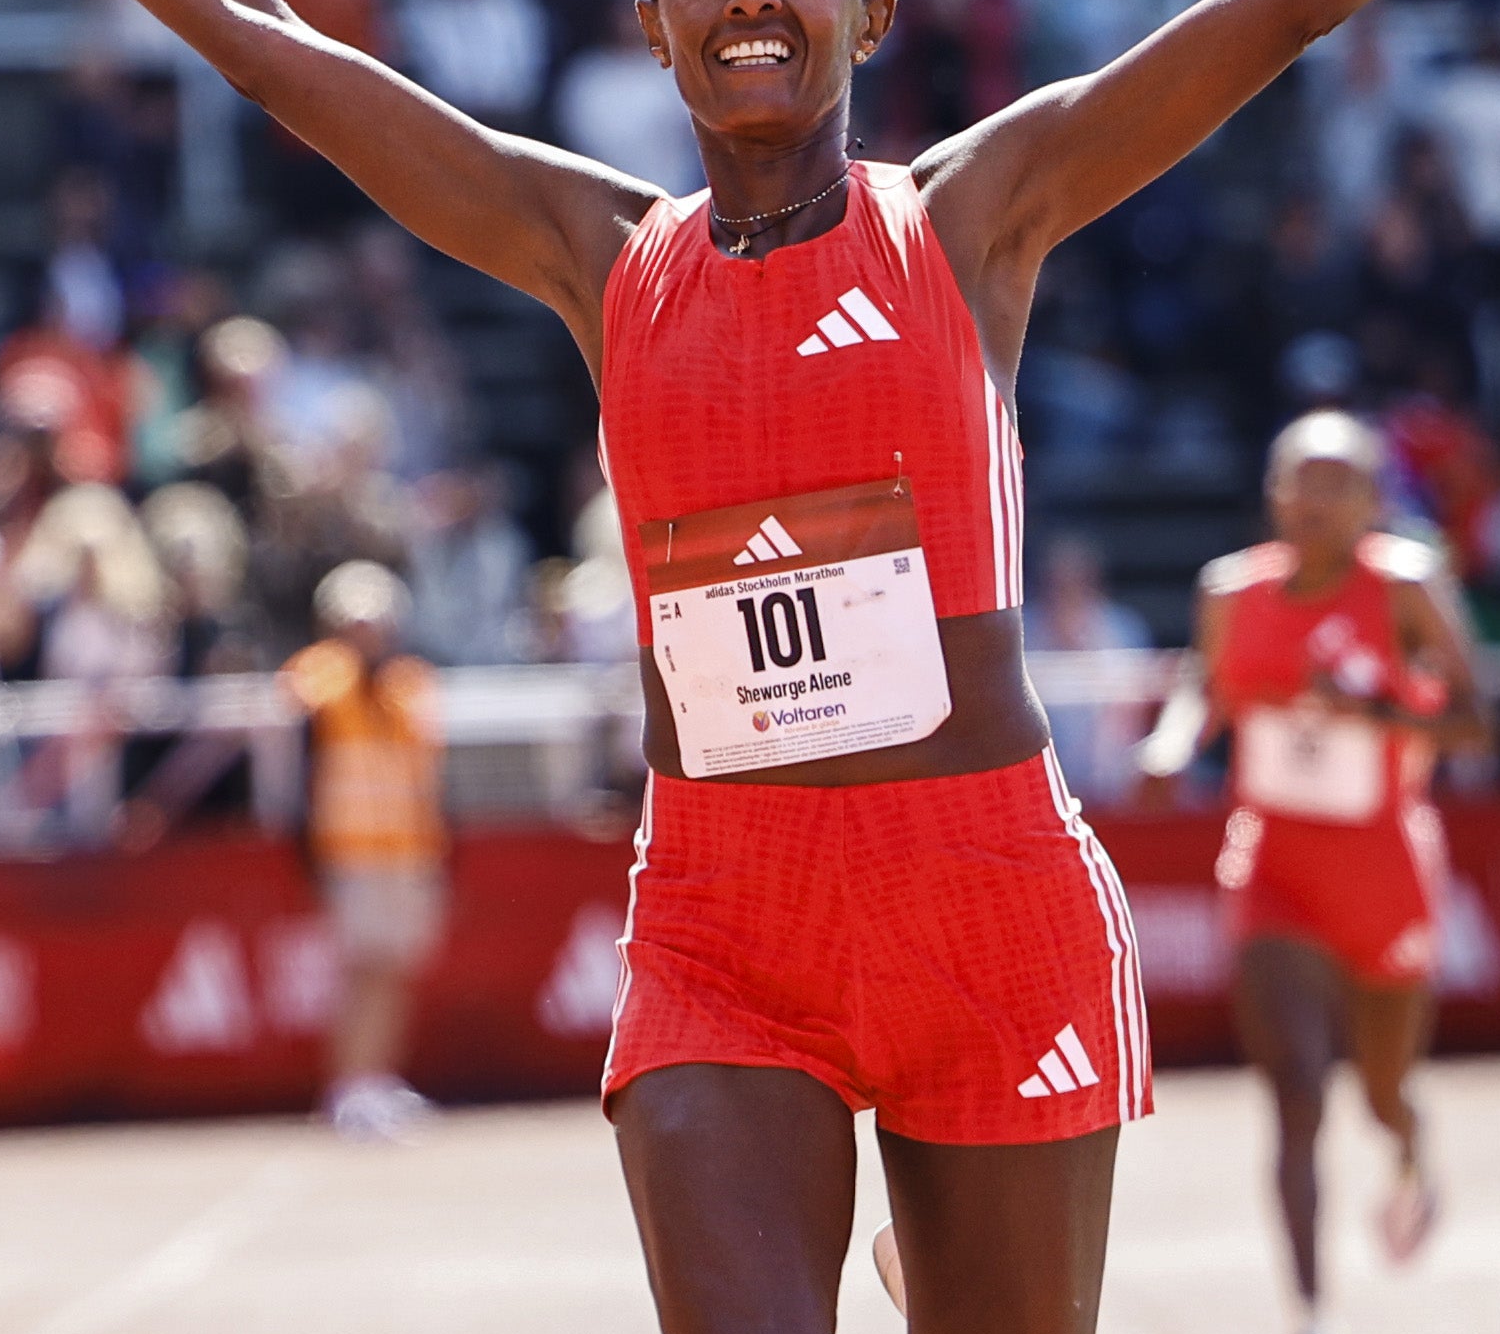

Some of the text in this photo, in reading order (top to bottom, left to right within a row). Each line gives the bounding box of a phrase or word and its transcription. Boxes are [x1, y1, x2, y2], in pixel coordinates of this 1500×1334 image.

[705, 566, 845, 600] adidas Stockholm Marathon
[674, 602, 682, 619] A
[736, 587, 826, 673] 101
[736, 671, 852, 705] Shewarge Alene
[770, 702, 847, 726] Voltaren
